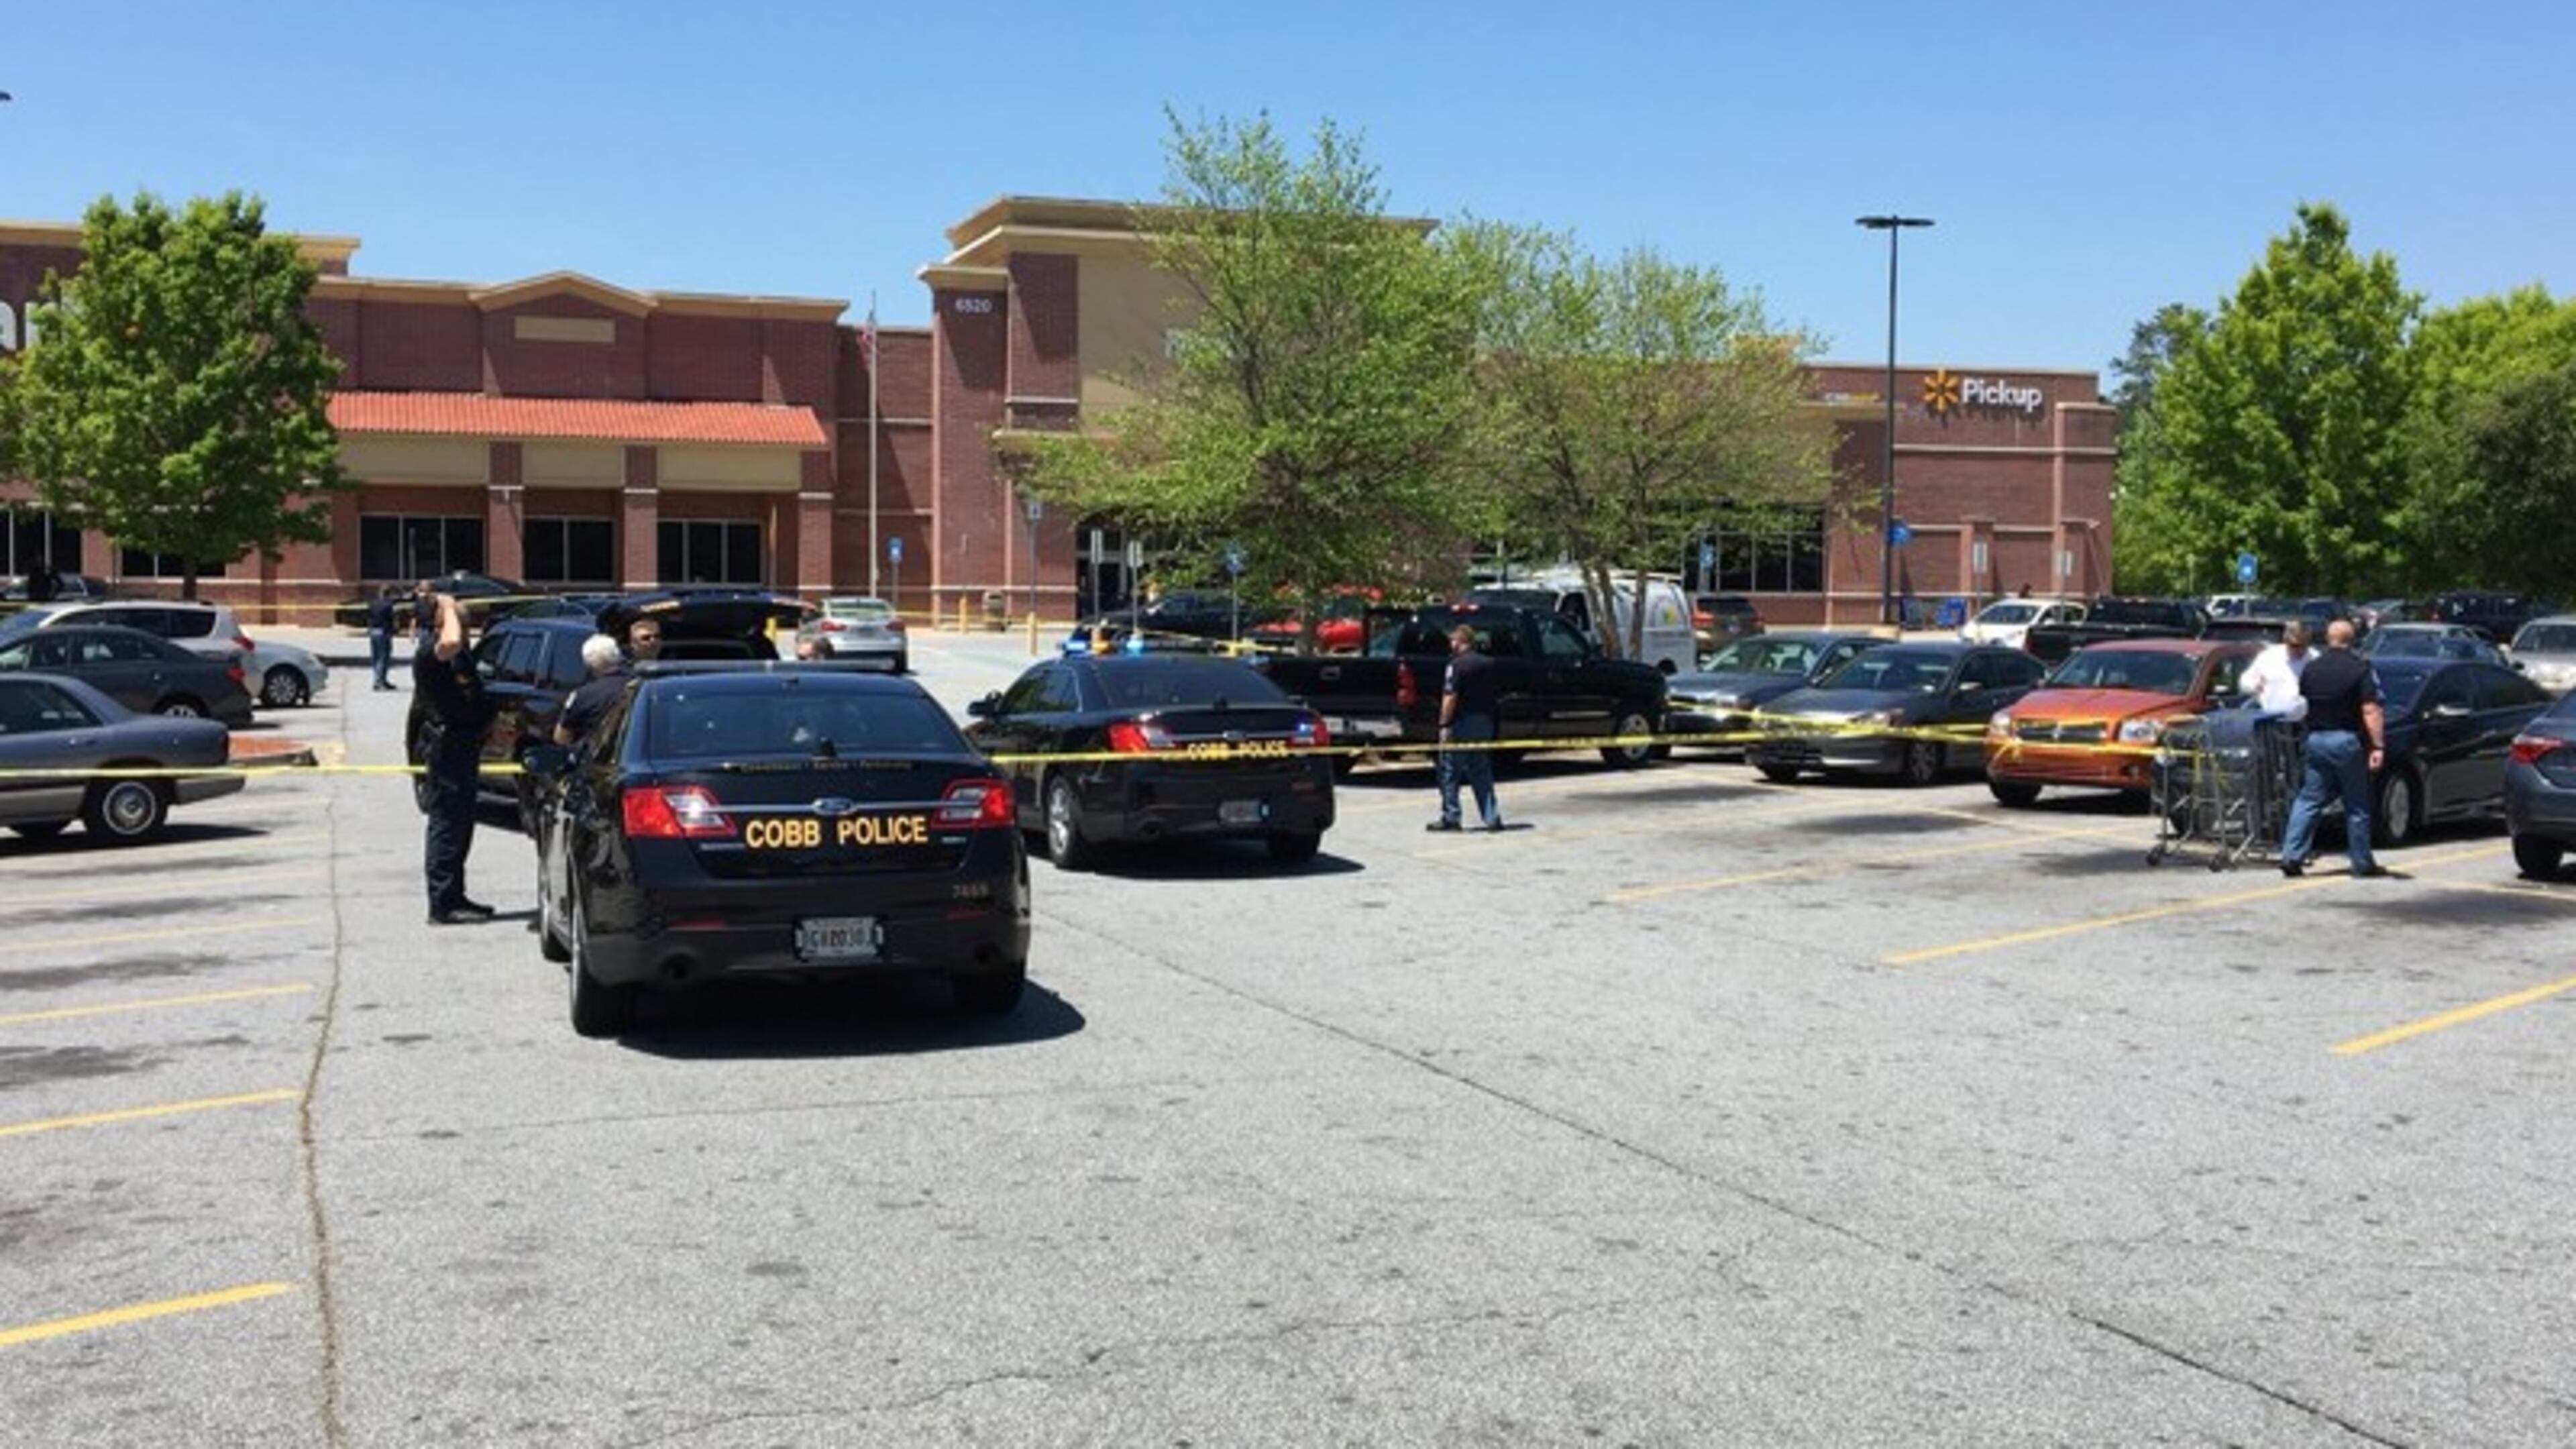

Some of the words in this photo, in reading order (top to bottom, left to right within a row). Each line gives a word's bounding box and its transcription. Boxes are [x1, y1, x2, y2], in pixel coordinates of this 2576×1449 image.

[955, 299, 992, 313] 6520
[1962, 378, 2043, 413] Pickup
[1238, 740, 1288, 759] POLICE
[745, 819, 822, 848] COBB
[838, 816, 929, 845] POLICE
